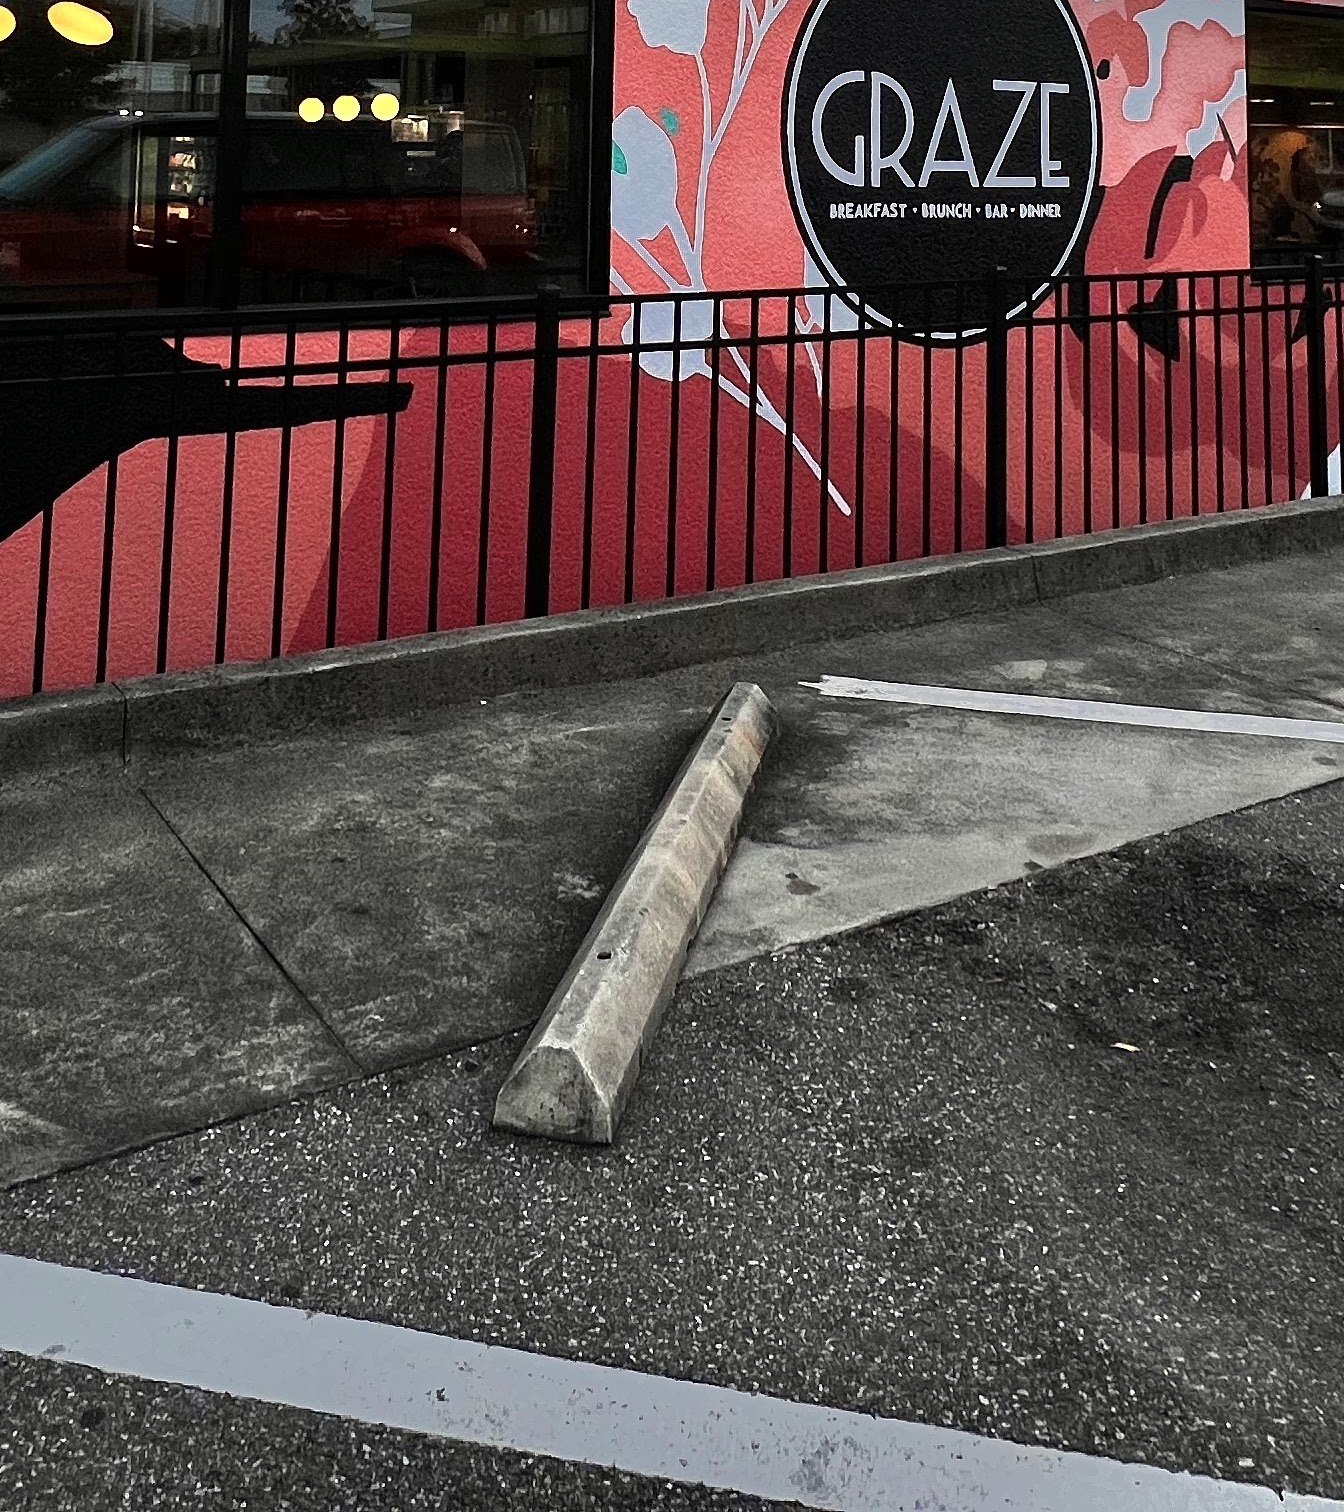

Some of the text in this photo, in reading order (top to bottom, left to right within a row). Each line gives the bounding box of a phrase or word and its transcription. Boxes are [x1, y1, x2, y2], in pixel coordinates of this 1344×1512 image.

[812, 70, 1070, 188] GRAZE
[829, 202, 1062, 219] BREAKFAST BRUNCH BAR DINNER
